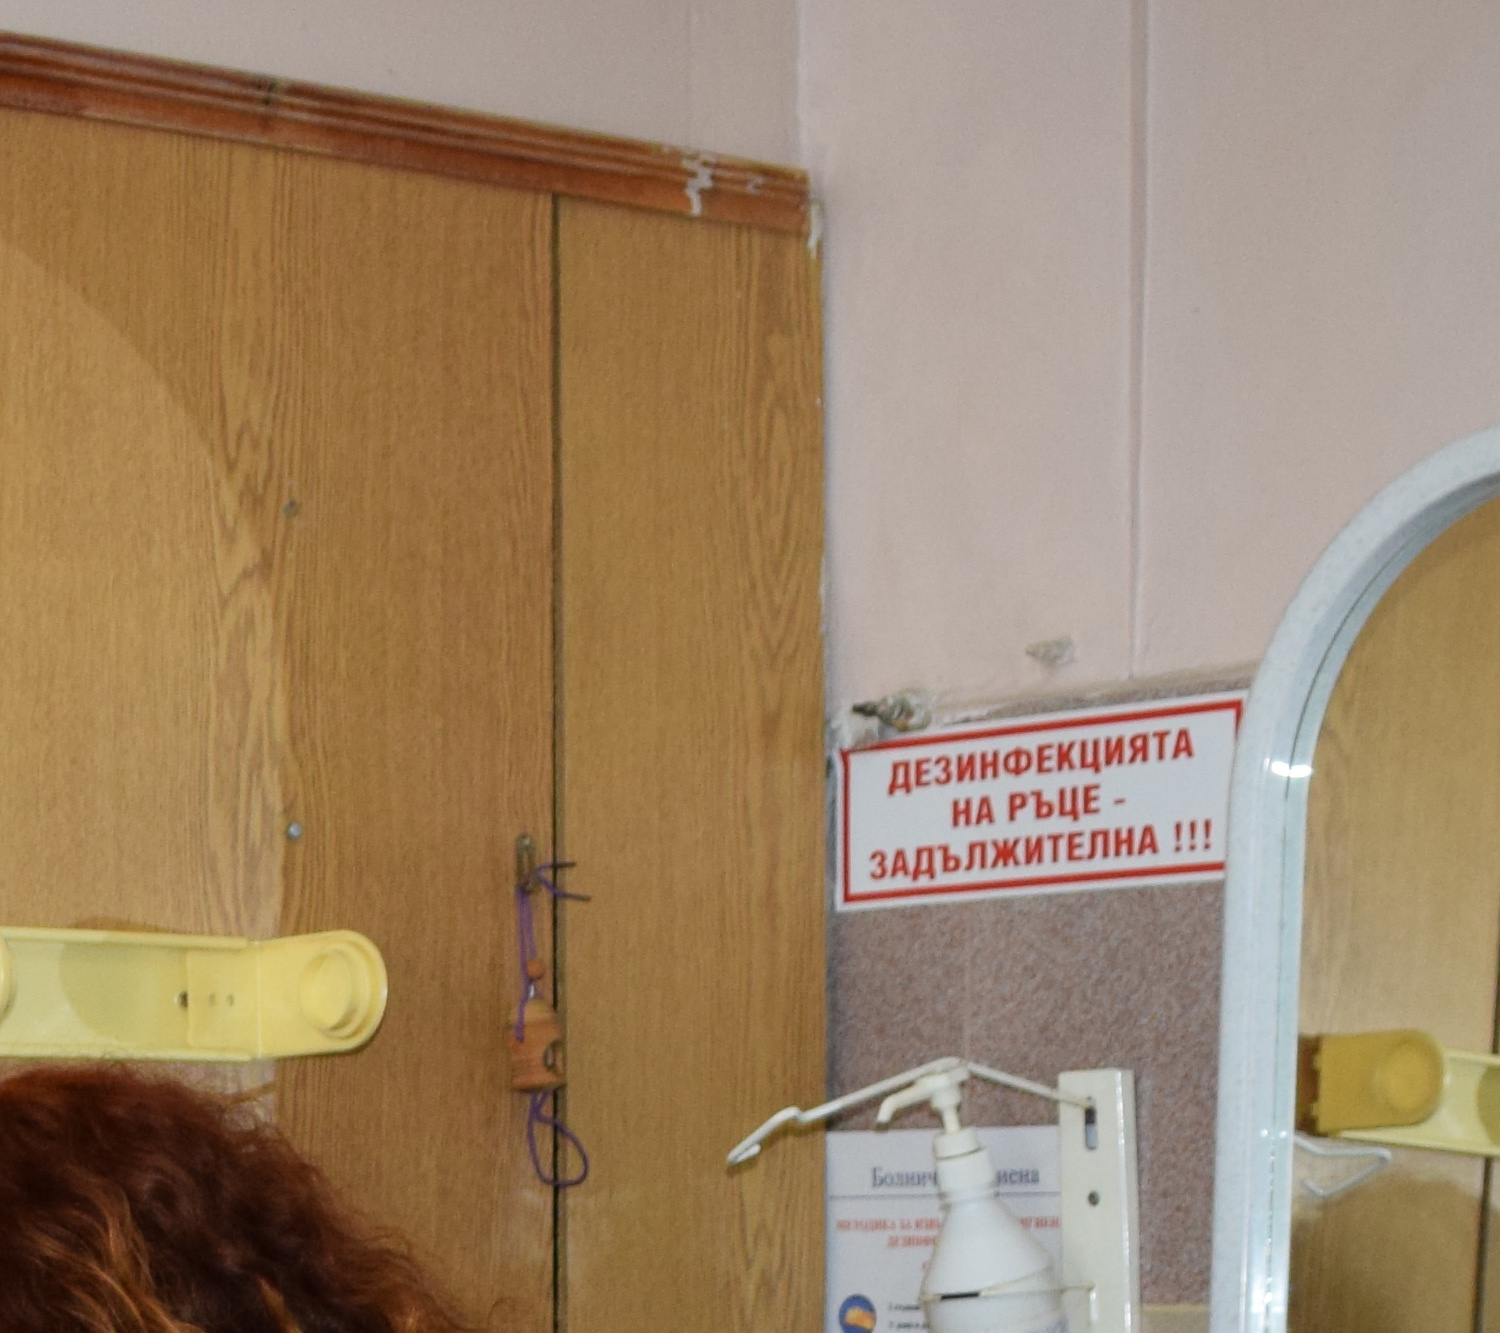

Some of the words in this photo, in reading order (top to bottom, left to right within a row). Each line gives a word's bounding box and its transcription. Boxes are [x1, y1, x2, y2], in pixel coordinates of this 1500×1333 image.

[888, 727, 1195, 796] ДЕЗИНФЕКЦИЯТА
[951, 795, 995, 828] НА
[1008, 784, 1101, 822] РЪЦЕ
[869, 824, 1160, 882] ЗАДЪЛЖИТЕЛНА
[1173, 819, 1213, 853] !!!
